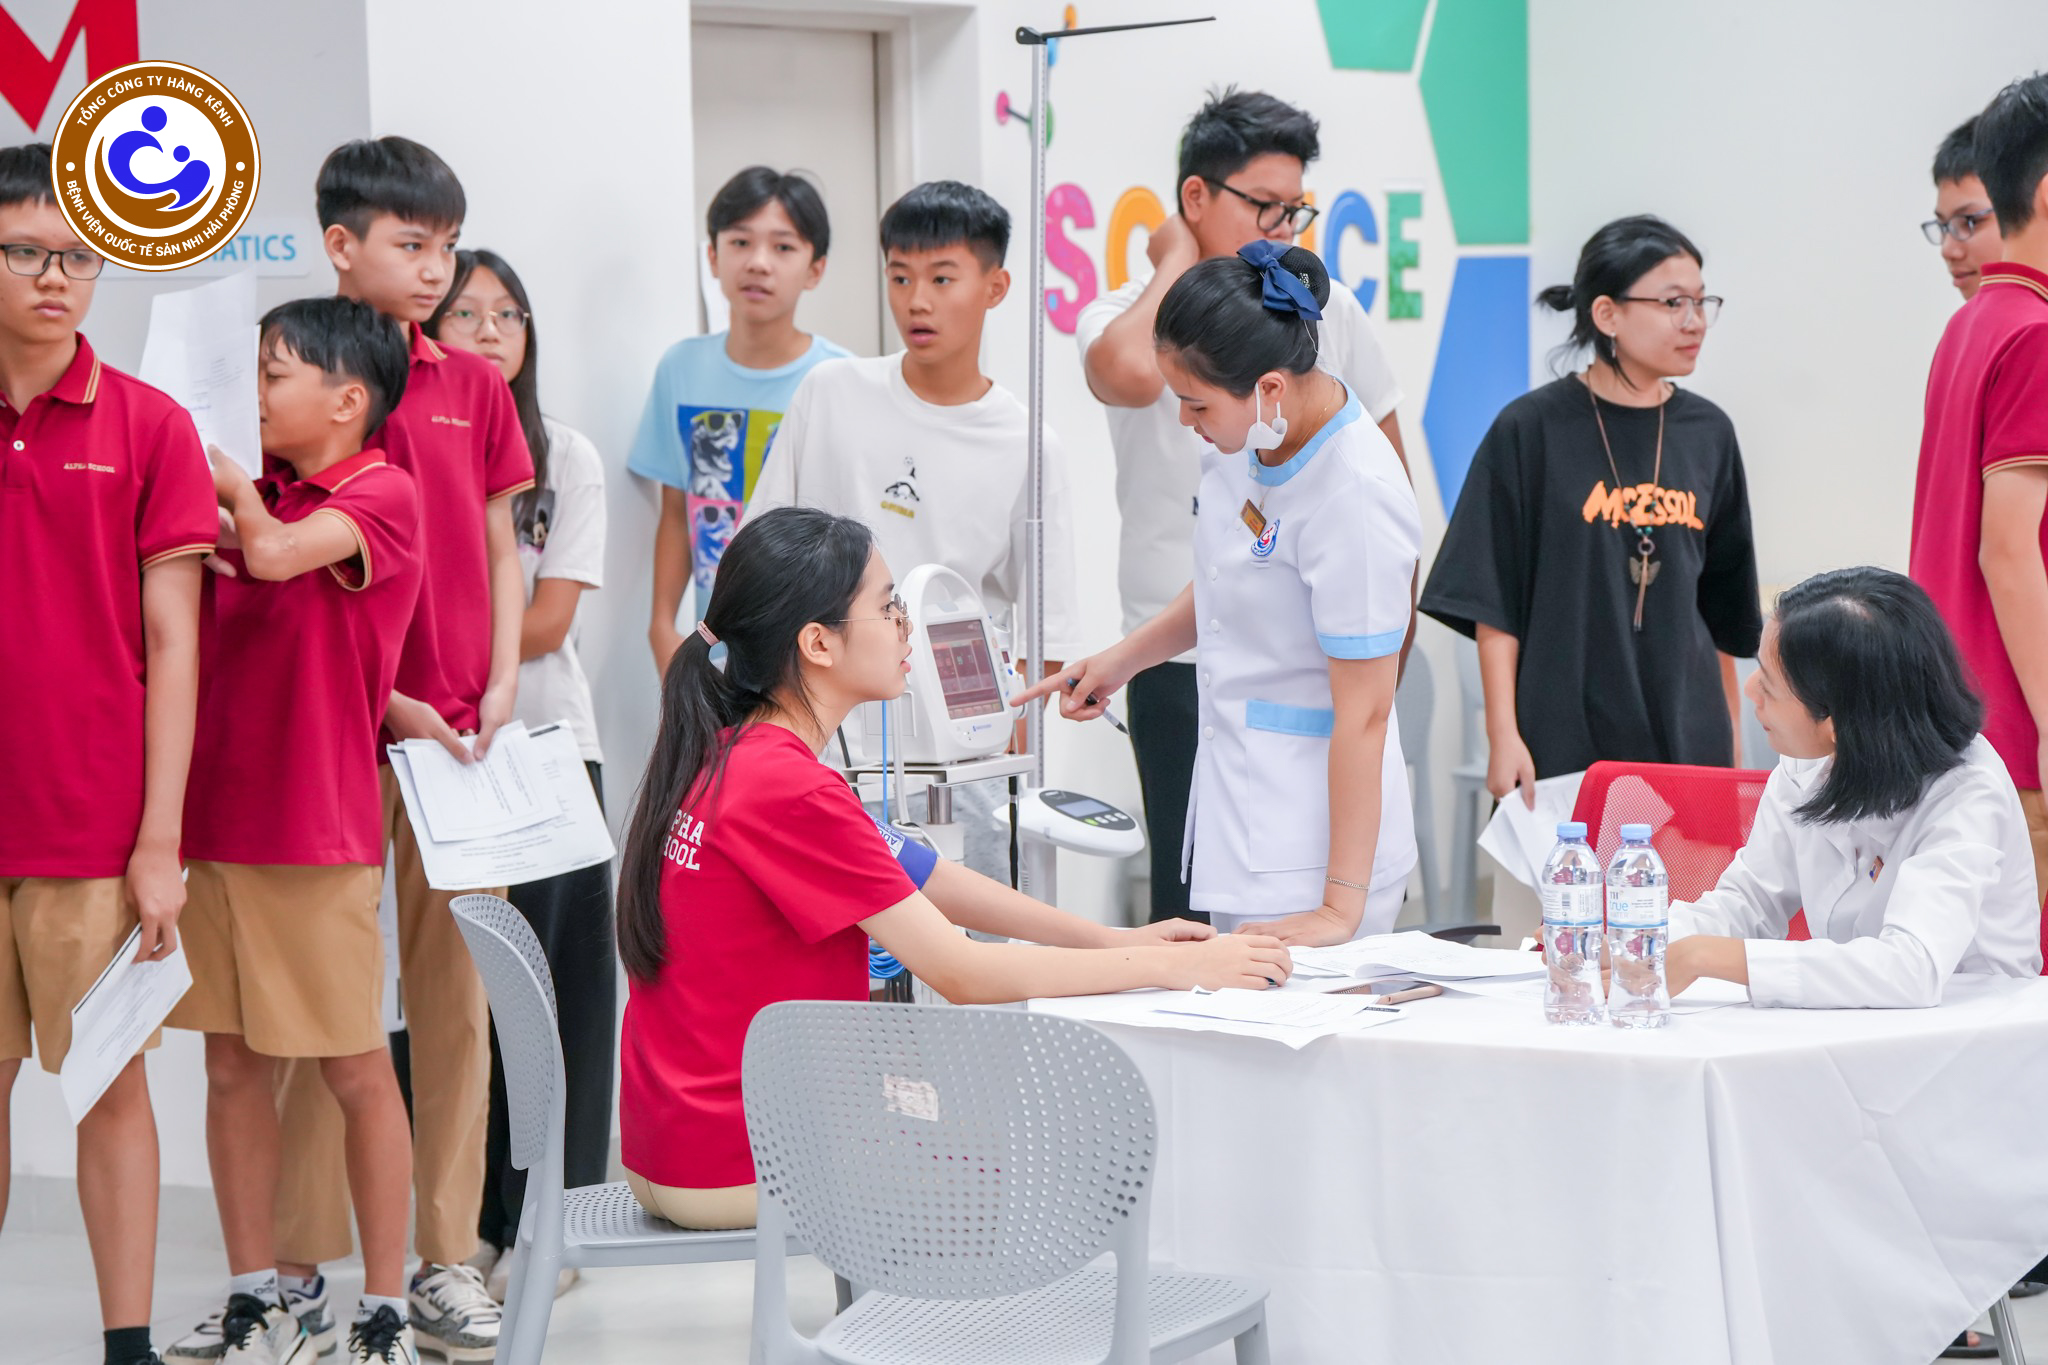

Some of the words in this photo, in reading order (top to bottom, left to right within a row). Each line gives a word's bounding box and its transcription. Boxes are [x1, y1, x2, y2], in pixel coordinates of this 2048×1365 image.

[212, 234, 296, 261] ATICS
[1045, 182, 1423, 334] SCCE
[671, 808, 705, 847] PHA
[1610, 899, 1629, 912] true
